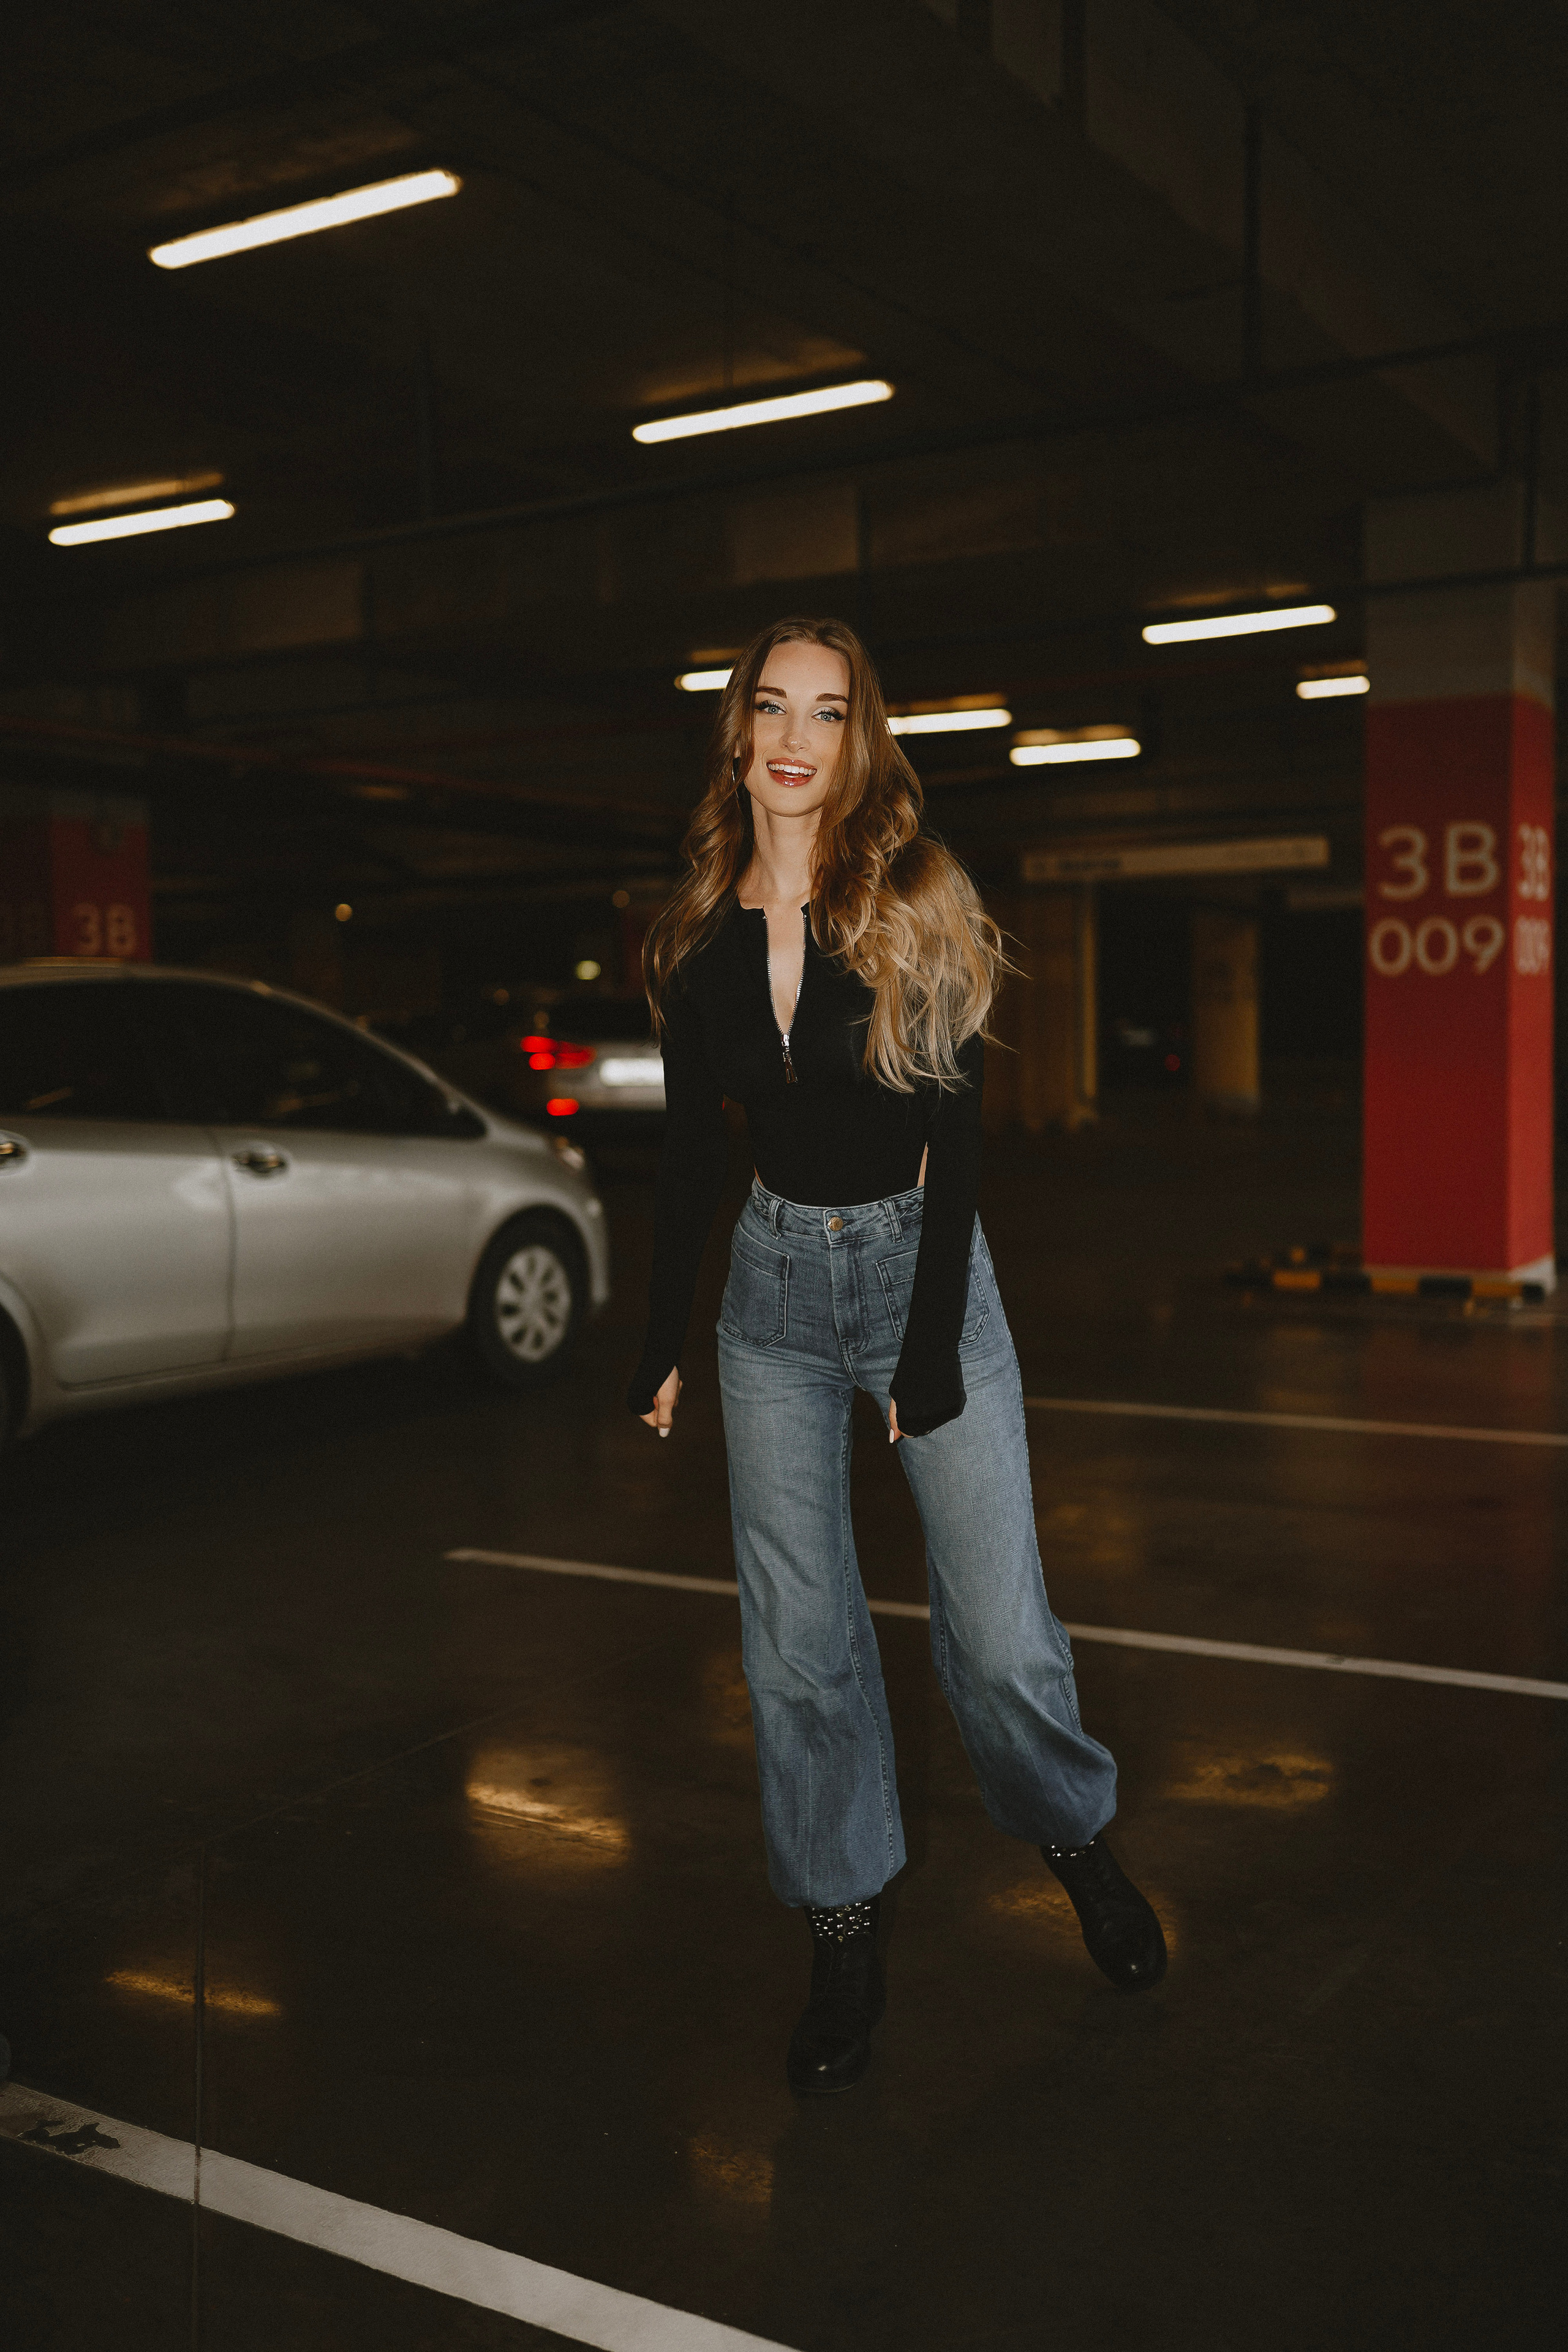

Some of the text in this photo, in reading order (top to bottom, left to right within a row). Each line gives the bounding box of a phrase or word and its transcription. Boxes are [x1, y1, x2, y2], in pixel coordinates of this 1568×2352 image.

[1379, 821, 1498, 898] 3B
[72, 902, 137, 956] 3B
[1370, 916, 1504, 976] 009
